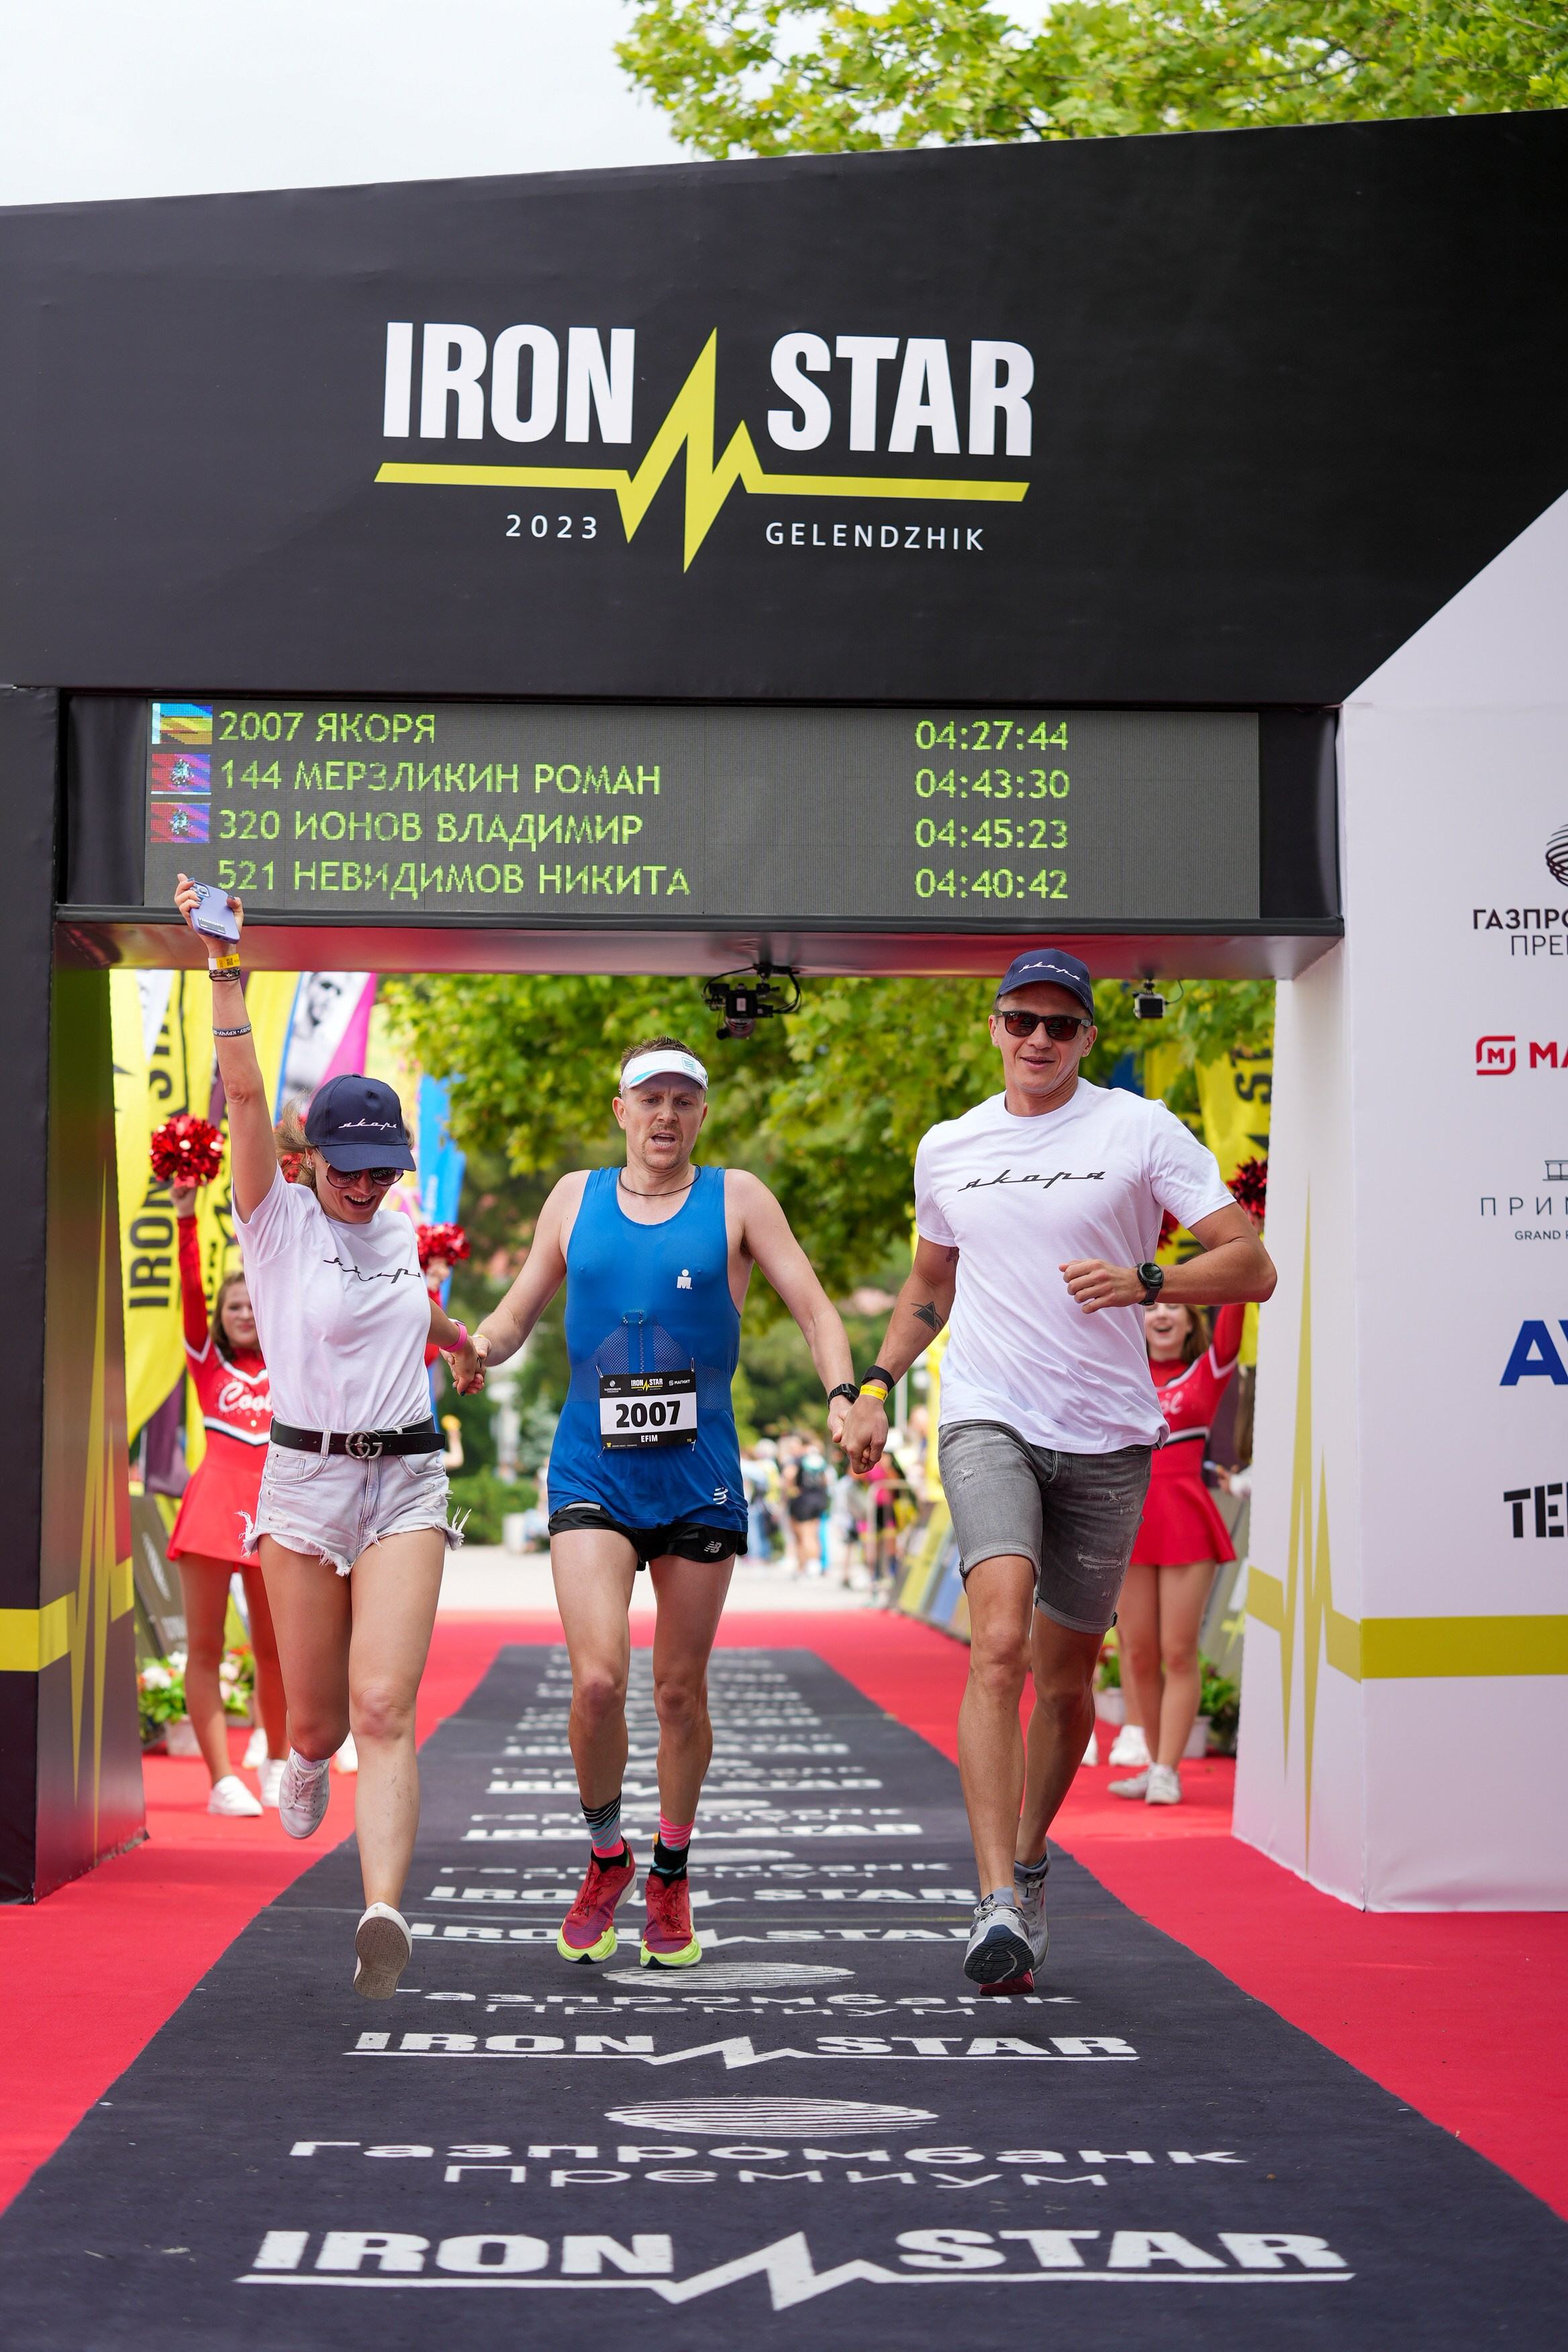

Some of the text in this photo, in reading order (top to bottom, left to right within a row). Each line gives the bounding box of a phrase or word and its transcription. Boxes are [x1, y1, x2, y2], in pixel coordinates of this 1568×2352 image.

[383, 322, 1035, 456] IRON STAR
[506, 514, 985, 550] 2023 GELENDZHIK
[219, 711, 1069, 750] 2007 ЯКОРЯ 04:27:44
[221, 759, 1070, 799] 144 МЕРЗЛИКИН РОМАН 04:43:30
[219, 810, 1069, 852] 320 ИОНОВ ВЛАДИМИР 04:45:23
[217, 859, 1069, 901] 521 НЕВИДИМОВ НИКИТА 04:40:42
[1510, 935, 1568, 957] ПРЕ
[1529, 1042, 1568, 1069] М
[1481, 1197, 1568, 1216] ПРИ
[1514, 1230, 1561, 1241] GRAND
[616, 1400, 681, 1428] 2007
[641, 1434, 658, 1442] EFIM
[1503, 1482, 1568, 1538] TE
[754, 1889, 977, 1902] STAR
[355, 2032, 1138, 2055] IRON STAR
[289, 2141, 1247, 2164] Газпромбанк
[444, 2165, 1108, 2189] Премиум
[252, 2228, 1349, 2273] IRON STAR
